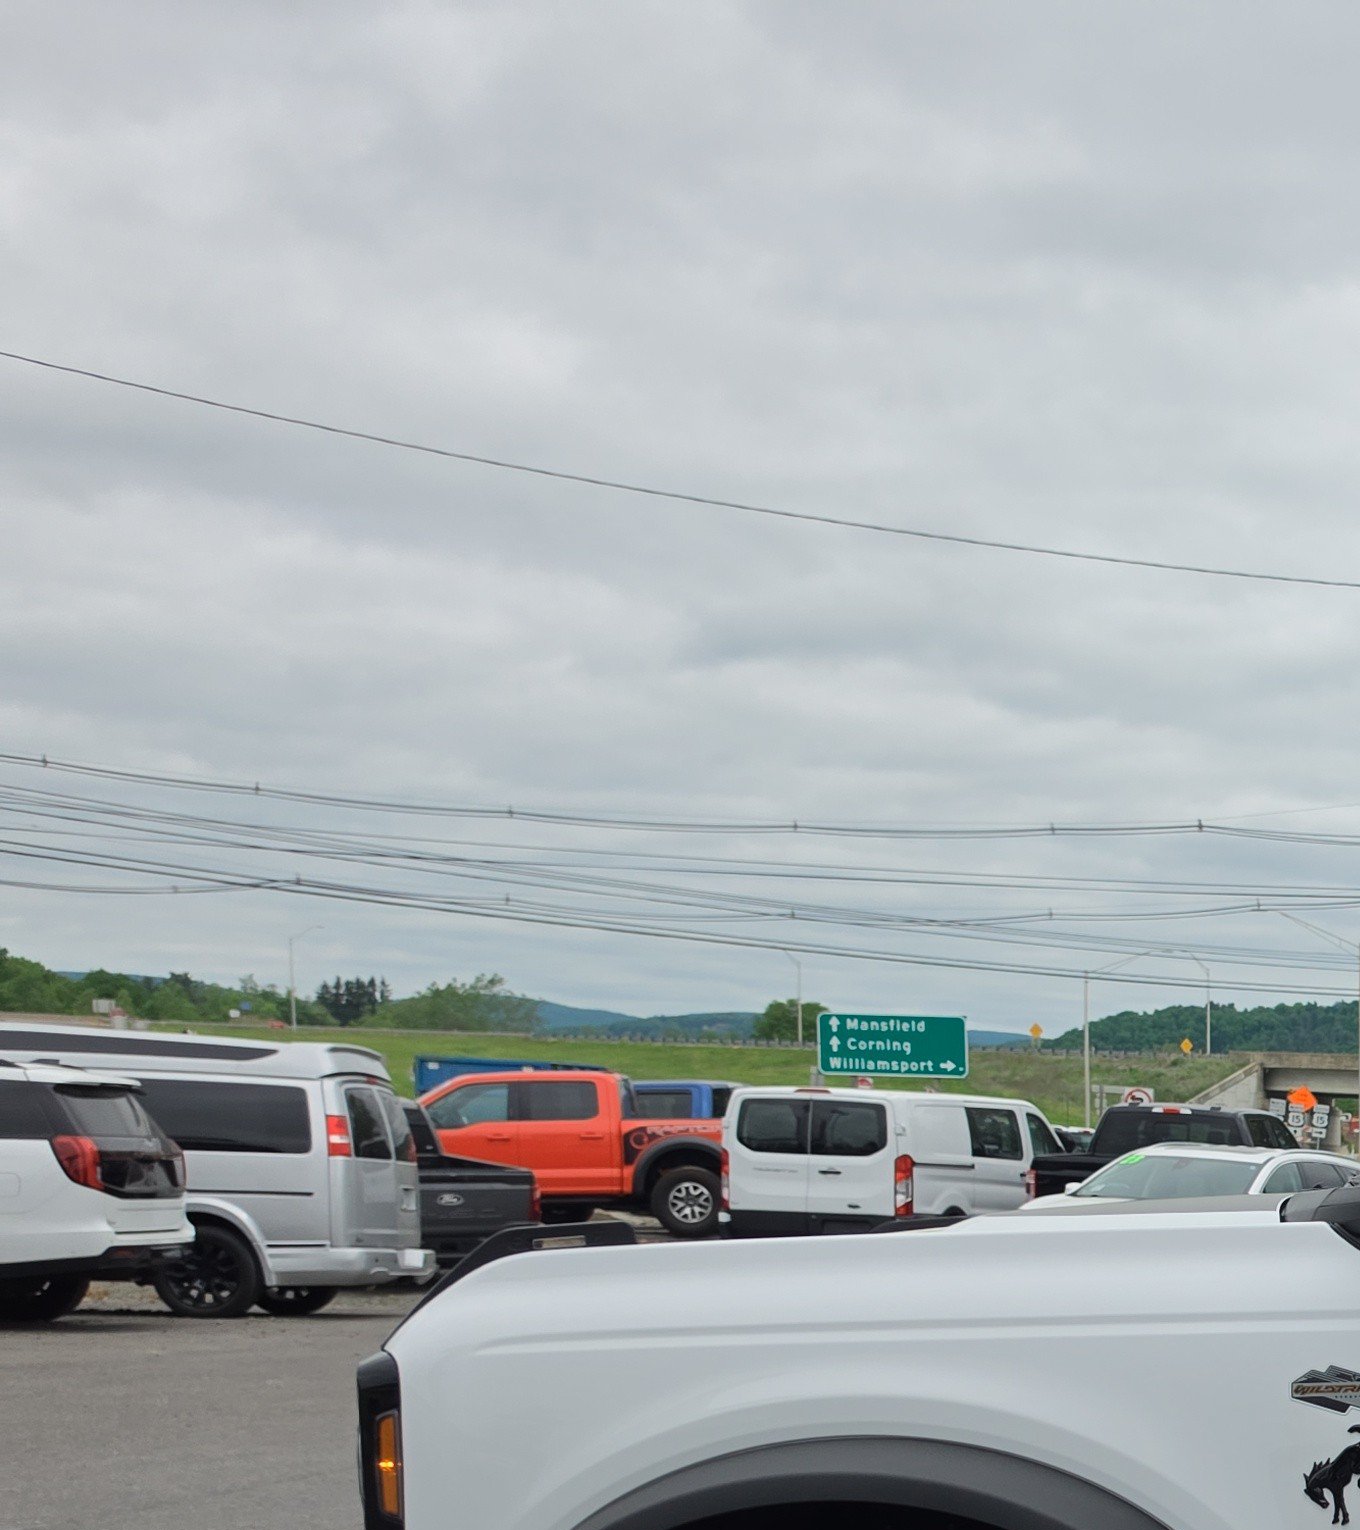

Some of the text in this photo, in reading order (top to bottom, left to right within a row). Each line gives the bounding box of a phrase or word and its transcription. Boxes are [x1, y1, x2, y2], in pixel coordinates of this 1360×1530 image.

[845, 1018, 926, 1033] Mansfield
[846, 1037, 912, 1055] Corning
[829, 1057, 934, 1073] Williamsport
